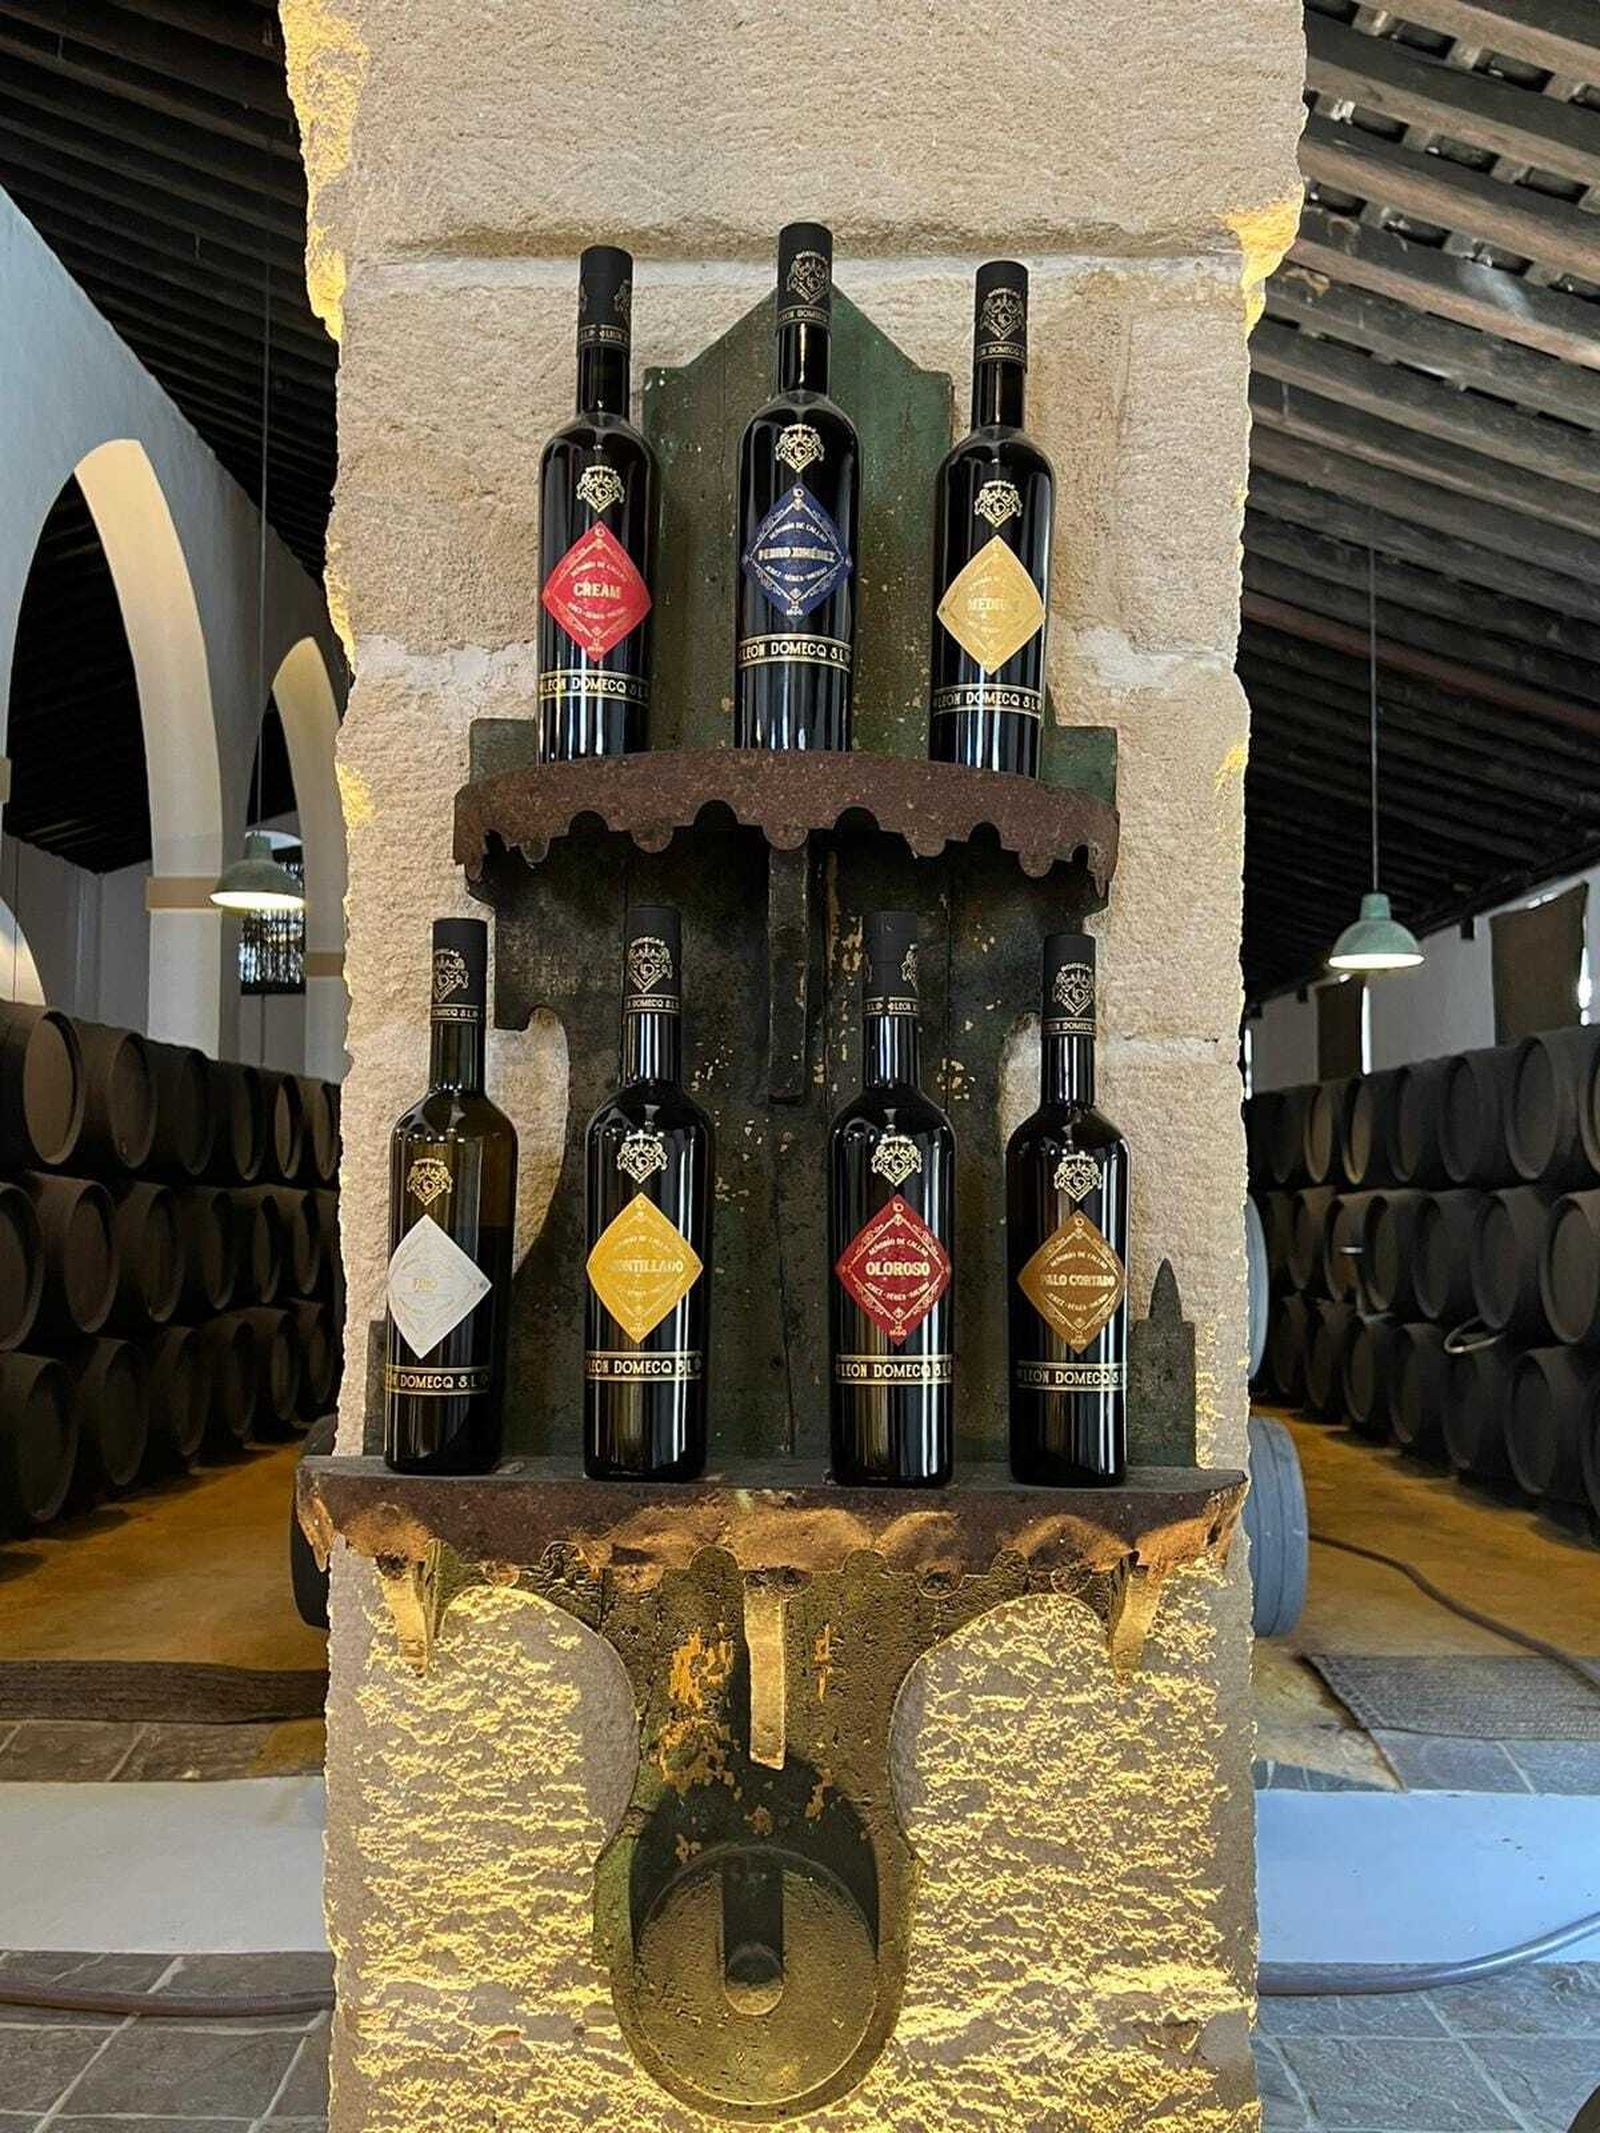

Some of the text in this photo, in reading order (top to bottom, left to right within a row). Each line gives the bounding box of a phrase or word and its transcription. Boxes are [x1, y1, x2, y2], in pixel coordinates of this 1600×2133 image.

[573, 582, 622, 599] CREAM
[771, 641, 827, 657] DOMECQ
[572, 677, 627, 693] DOMECQ
[965, 691, 1020, 706] DOMECQ
[865, 1261, 930, 1276] OLOROSO
[1069, 1274, 1116, 1287] CORTADO
[614, 1360, 672, 1374] DOMECQ
[873, 1364, 931, 1378] DOMECQ
[400, 1374, 454, 1388] DOMECQ
[1055, 1370, 1110, 1384] DOMECQ
